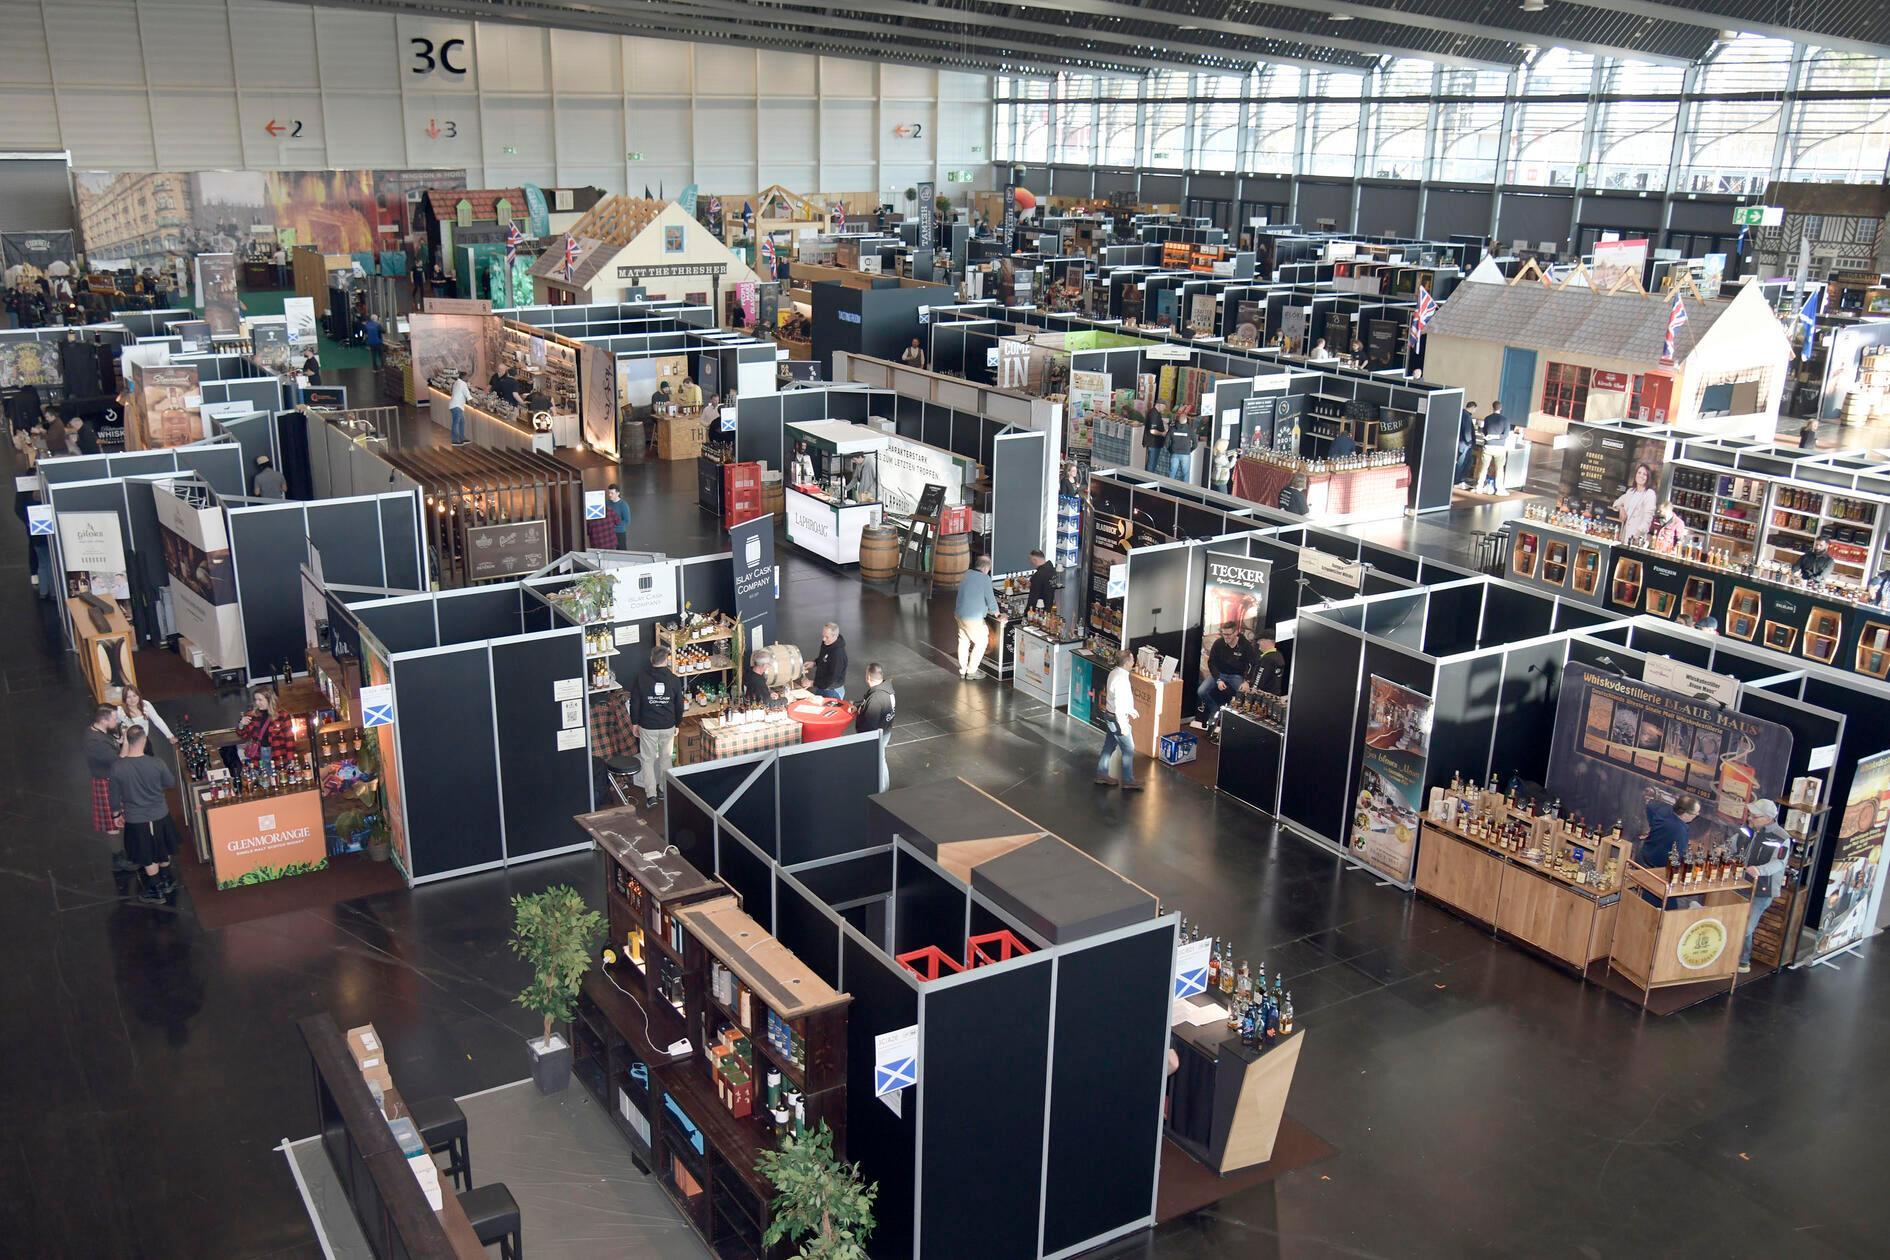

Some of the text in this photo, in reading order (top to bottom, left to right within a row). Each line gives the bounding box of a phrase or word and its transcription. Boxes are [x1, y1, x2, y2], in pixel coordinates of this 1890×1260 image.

[411, 38, 467, 74] 3C
[291, 120, 303, 138] 2
[445, 121, 457, 138] 3
[912, 124, 922, 138] 2
[619, 265, 727, 278] MATT THE THRESHER
[1004, 341, 1030, 355] COME
[1003, 356, 1030, 388] IN
[885, 444, 928, 463] HARAKTERSTARK
[795, 512, 829, 537] LAPHROAIG
[736, 565, 772, 586] ISLAY CASK
[1210, 563, 1265, 584] TECKER
[737, 577, 770, 595] COMPANY
[1583, 672, 1761, 736] Whiskydestillerie BLAUE MAUS
[227, 826, 310, 852] GLENMORANGIE
